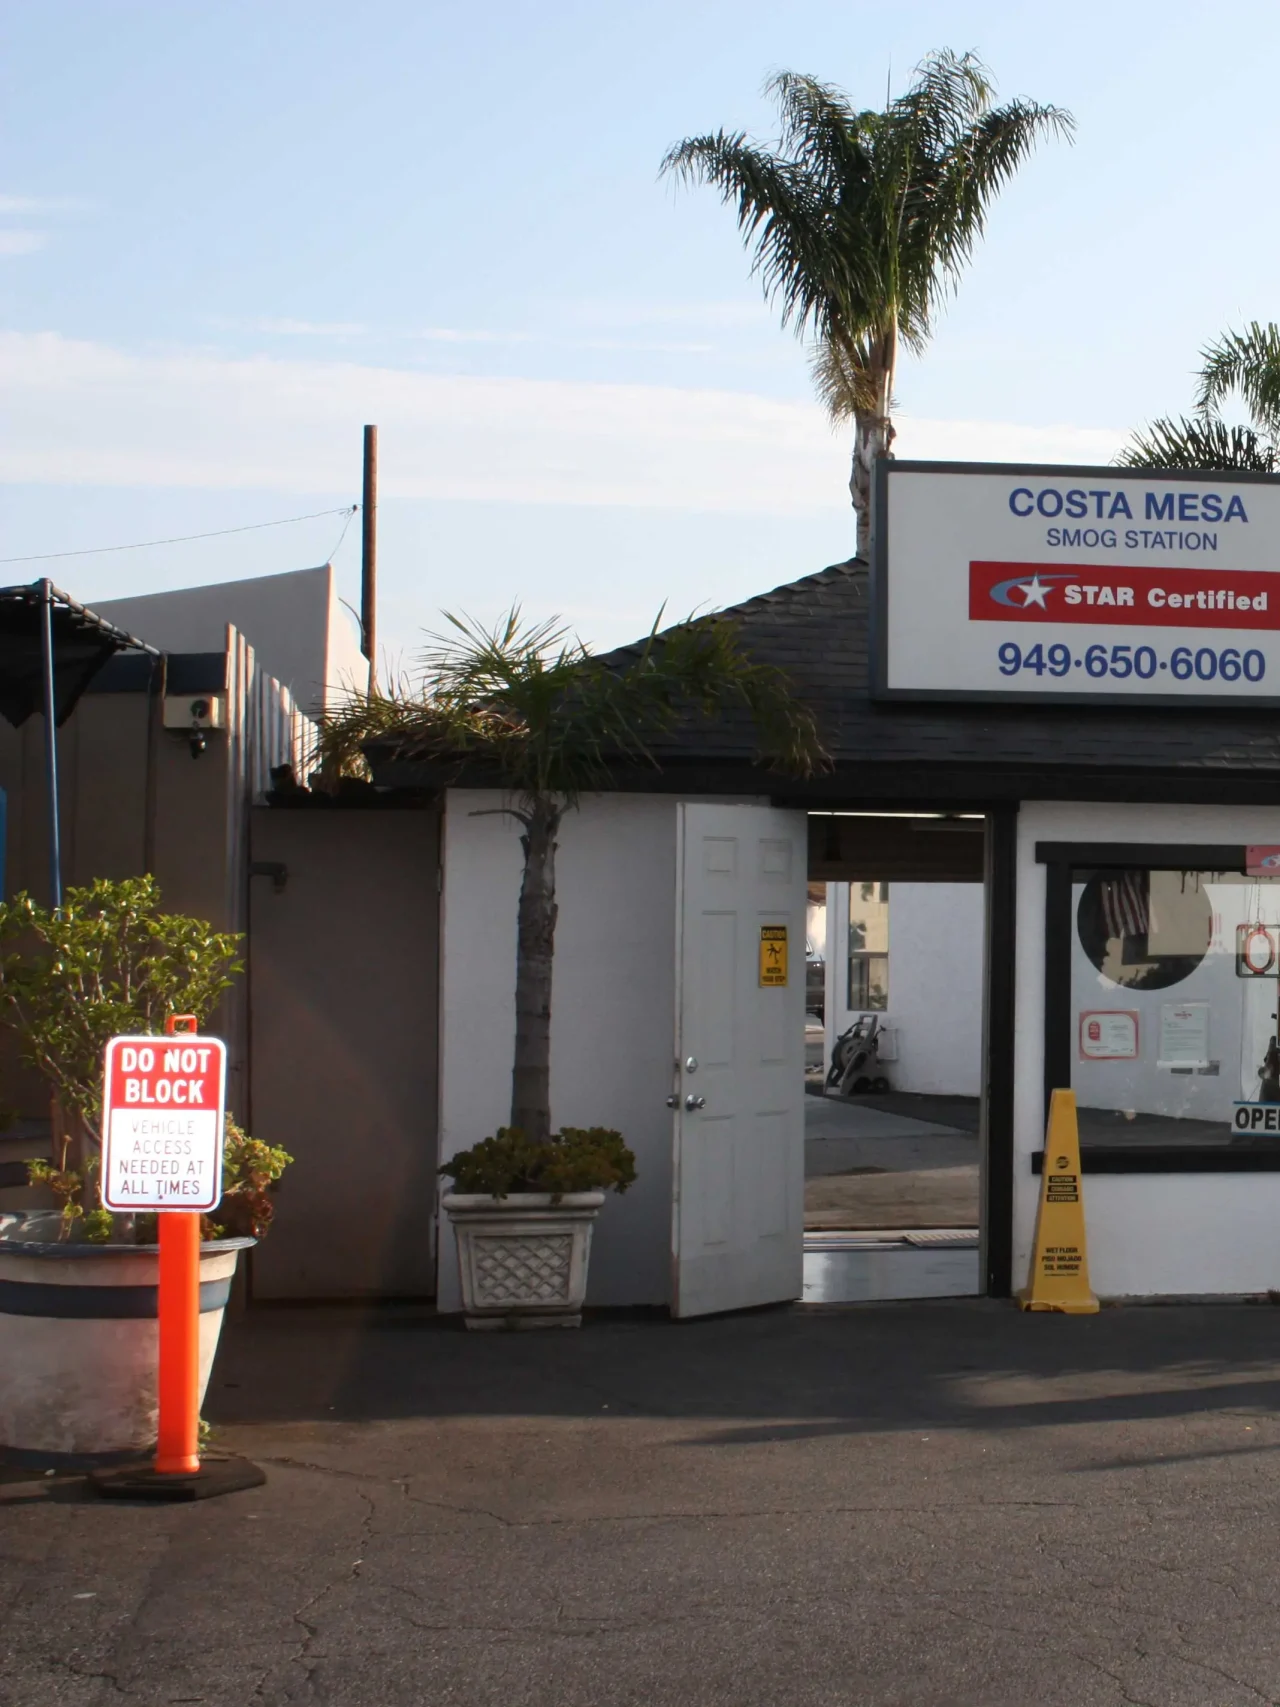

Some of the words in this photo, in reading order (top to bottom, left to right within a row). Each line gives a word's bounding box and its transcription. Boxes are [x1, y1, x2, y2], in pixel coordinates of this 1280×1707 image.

[1008, 487, 1133, 521] COSTA
[1145, 492, 1249, 523] MESA
[1046, 528, 1117, 549] SMOG
[1124, 530, 1218, 551] STATION
[1063, 585, 1135, 607] STAR
[1147, 587, 1268, 612] Certified
[121, 1047, 155, 1073] DO
[163, 1048, 212, 1073] NOT
[124, 1078, 204, 1104] BLOCK
[132, 1119, 195, 1135] VEHICLE
[132, 1140, 193, 1155] ACCESS
[119, 1159, 180, 1175] NEEDED
[186, 1160, 205, 1175] AT
[120, 1179, 149, 1195] ALL
[156, 1179, 200, 1195] TIMES
